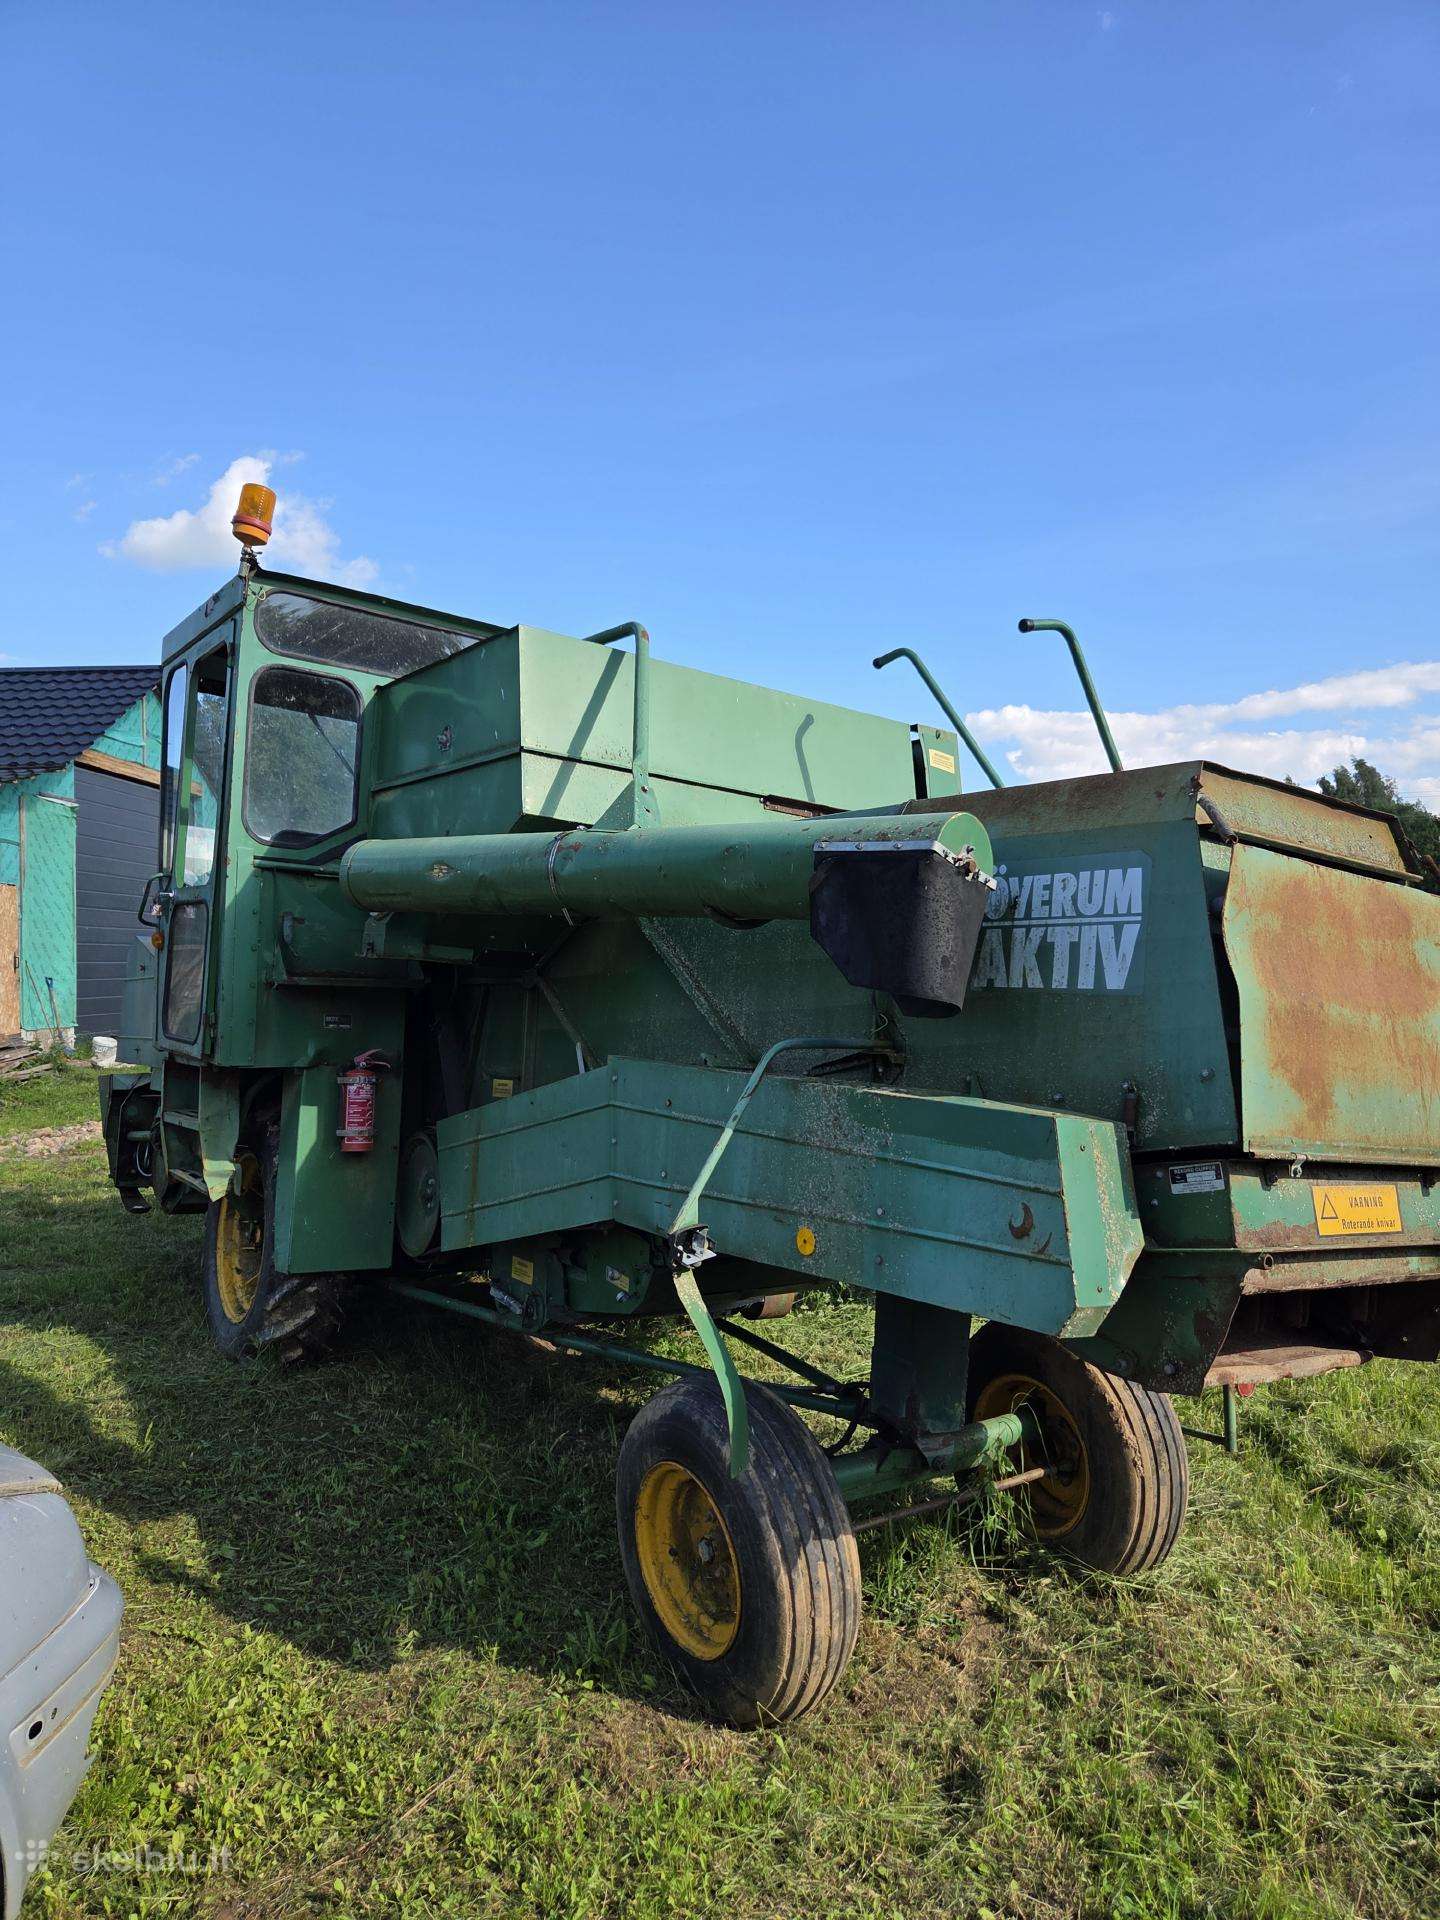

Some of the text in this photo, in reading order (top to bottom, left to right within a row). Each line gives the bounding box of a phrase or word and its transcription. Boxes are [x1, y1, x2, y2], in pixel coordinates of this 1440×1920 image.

[985, 864, 1142, 919] ÖVERUM
[973, 924, 1142, 989] AKTIV
[1348, 1196, 1384, 1209] VARNING
[1341, 1217, 1396, 1230] Roterande knivar
